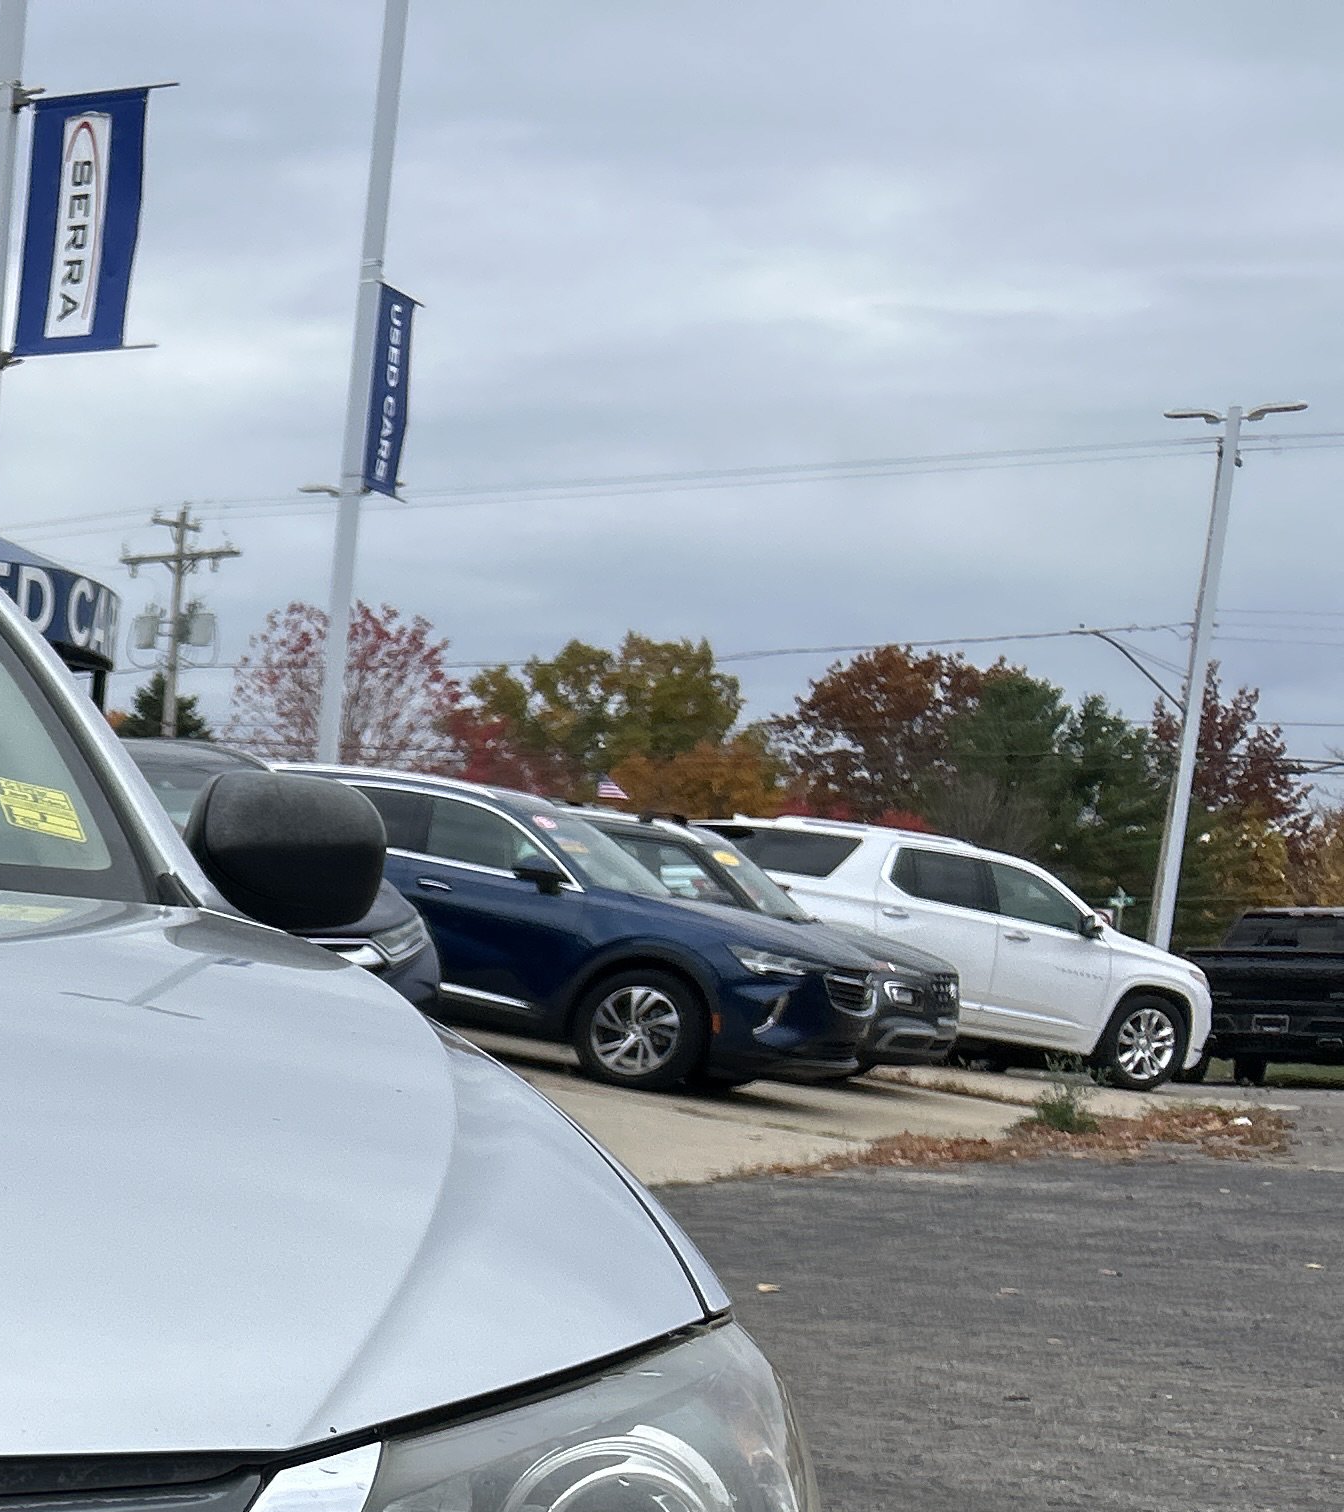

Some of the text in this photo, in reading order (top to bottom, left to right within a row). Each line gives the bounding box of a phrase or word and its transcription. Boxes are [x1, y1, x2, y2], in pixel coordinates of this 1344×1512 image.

[56, 160, 93, 322] SERRA
[374, 303, 404, 482] USED CARS
